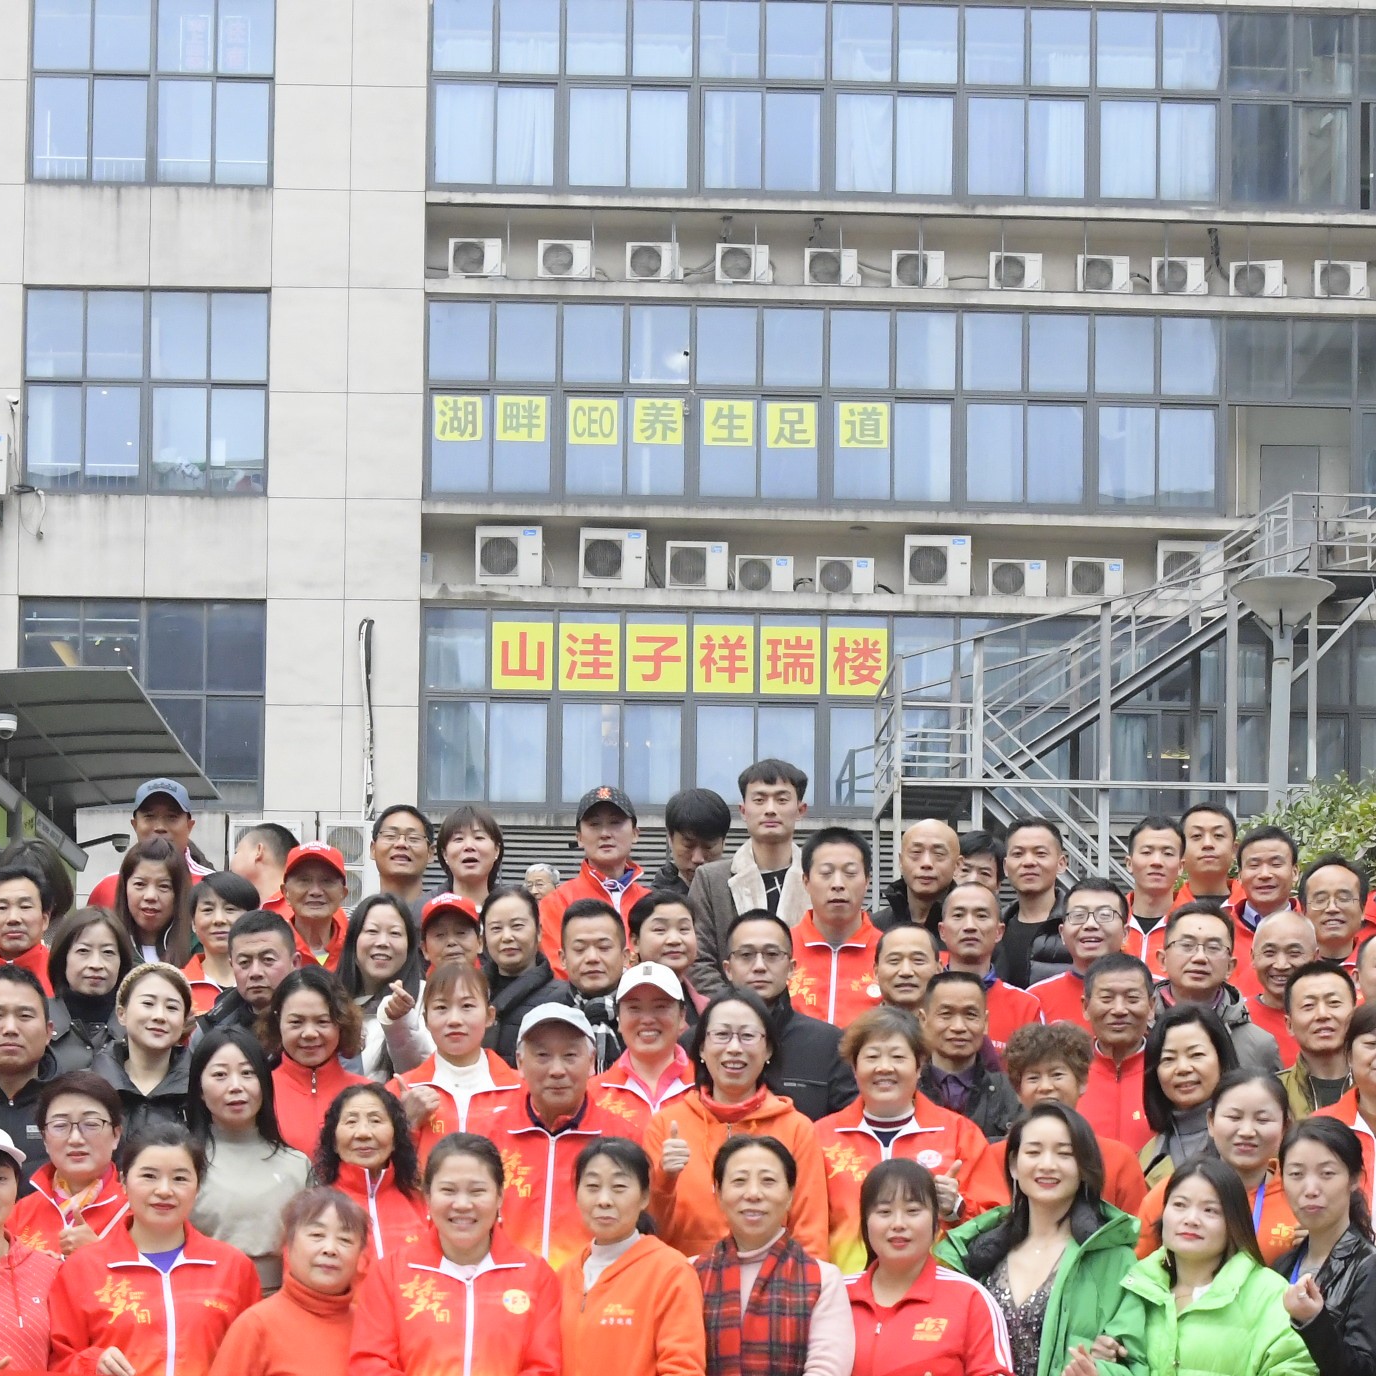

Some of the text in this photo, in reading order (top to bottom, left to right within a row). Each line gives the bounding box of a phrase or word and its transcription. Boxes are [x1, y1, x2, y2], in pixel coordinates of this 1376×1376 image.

[438, 397, 887, 446] 湖畔CEO养生足道
[501, 631, 886, 687] 山洼子祥瑞楼
